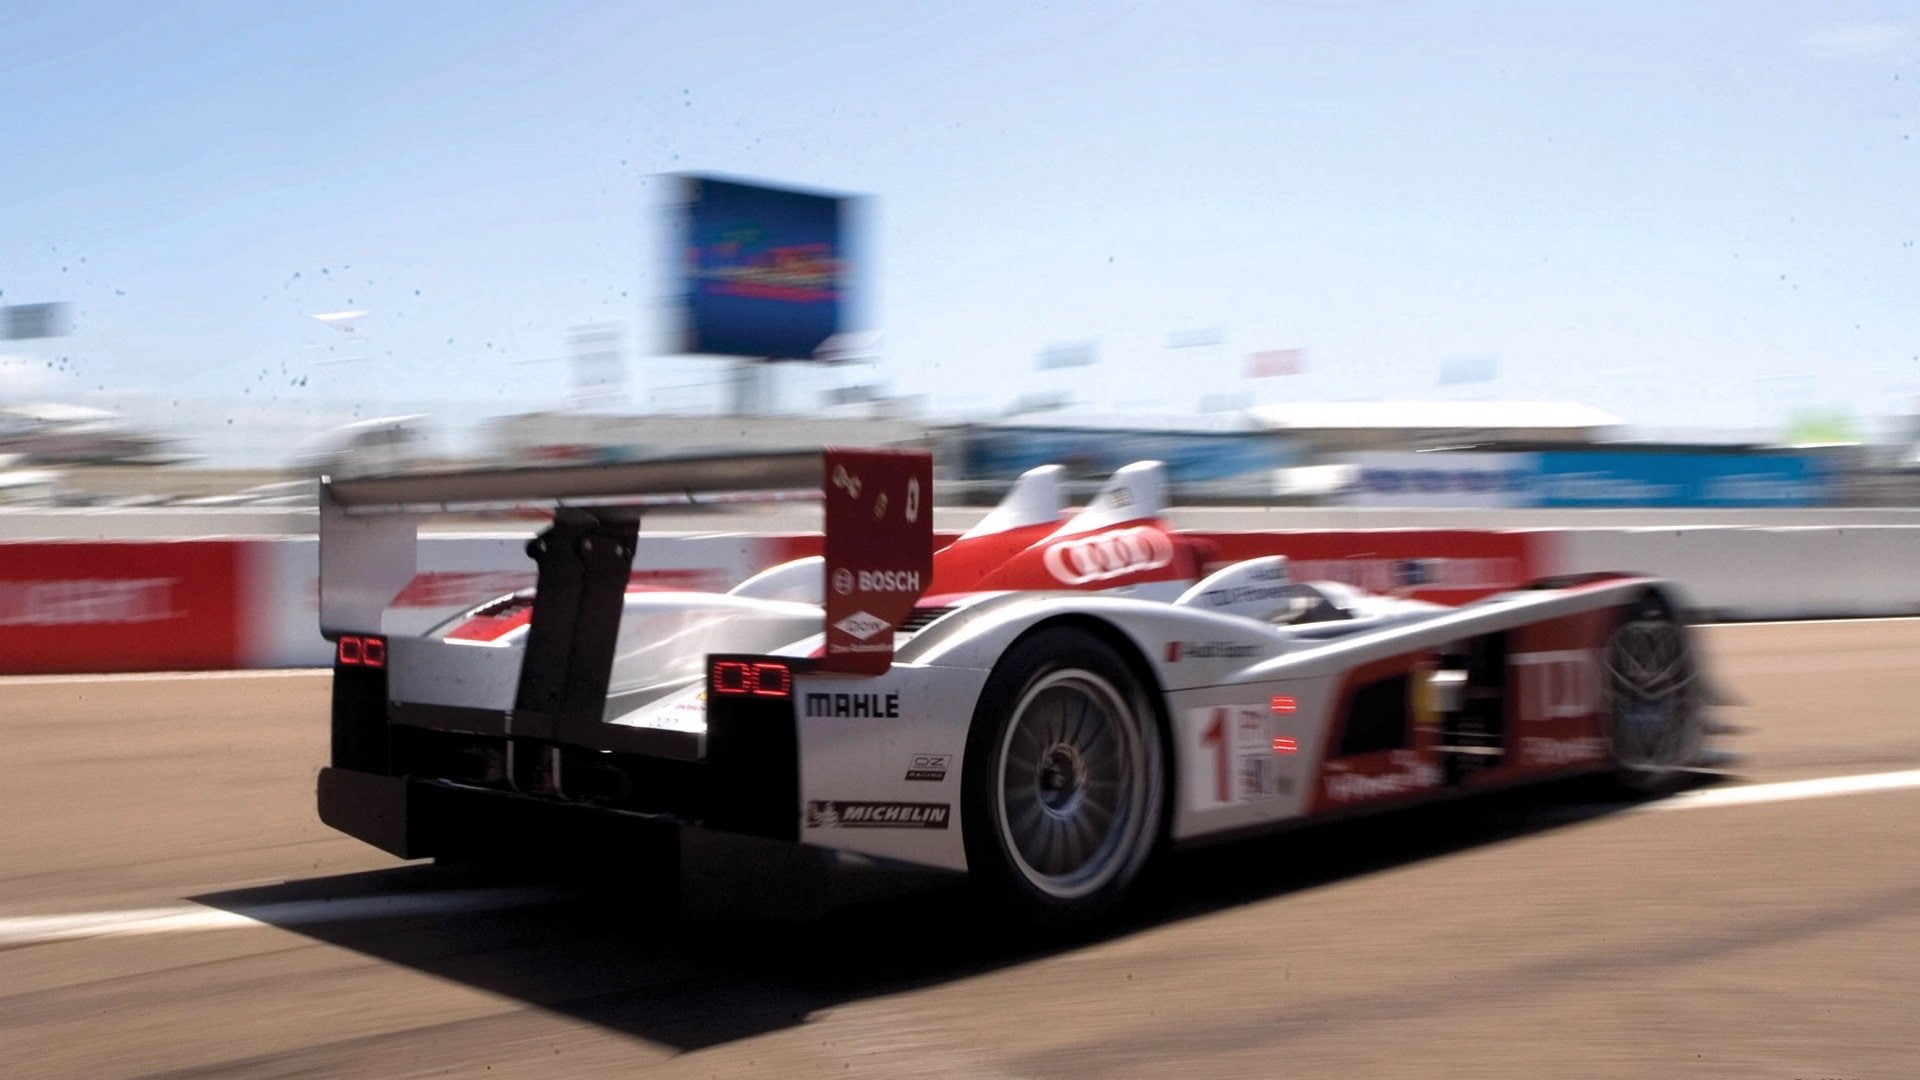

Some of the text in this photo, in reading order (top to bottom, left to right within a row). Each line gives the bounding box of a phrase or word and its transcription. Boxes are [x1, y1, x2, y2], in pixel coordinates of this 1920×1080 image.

[858, 570, 919, 591] BOSCH
[805, 693, 899, 718] MAHLE
[914, 757, 945, 766] OZ
[1200, 708, 1230, 801] 1
[843, 805, 946, 822] MICHELIN
